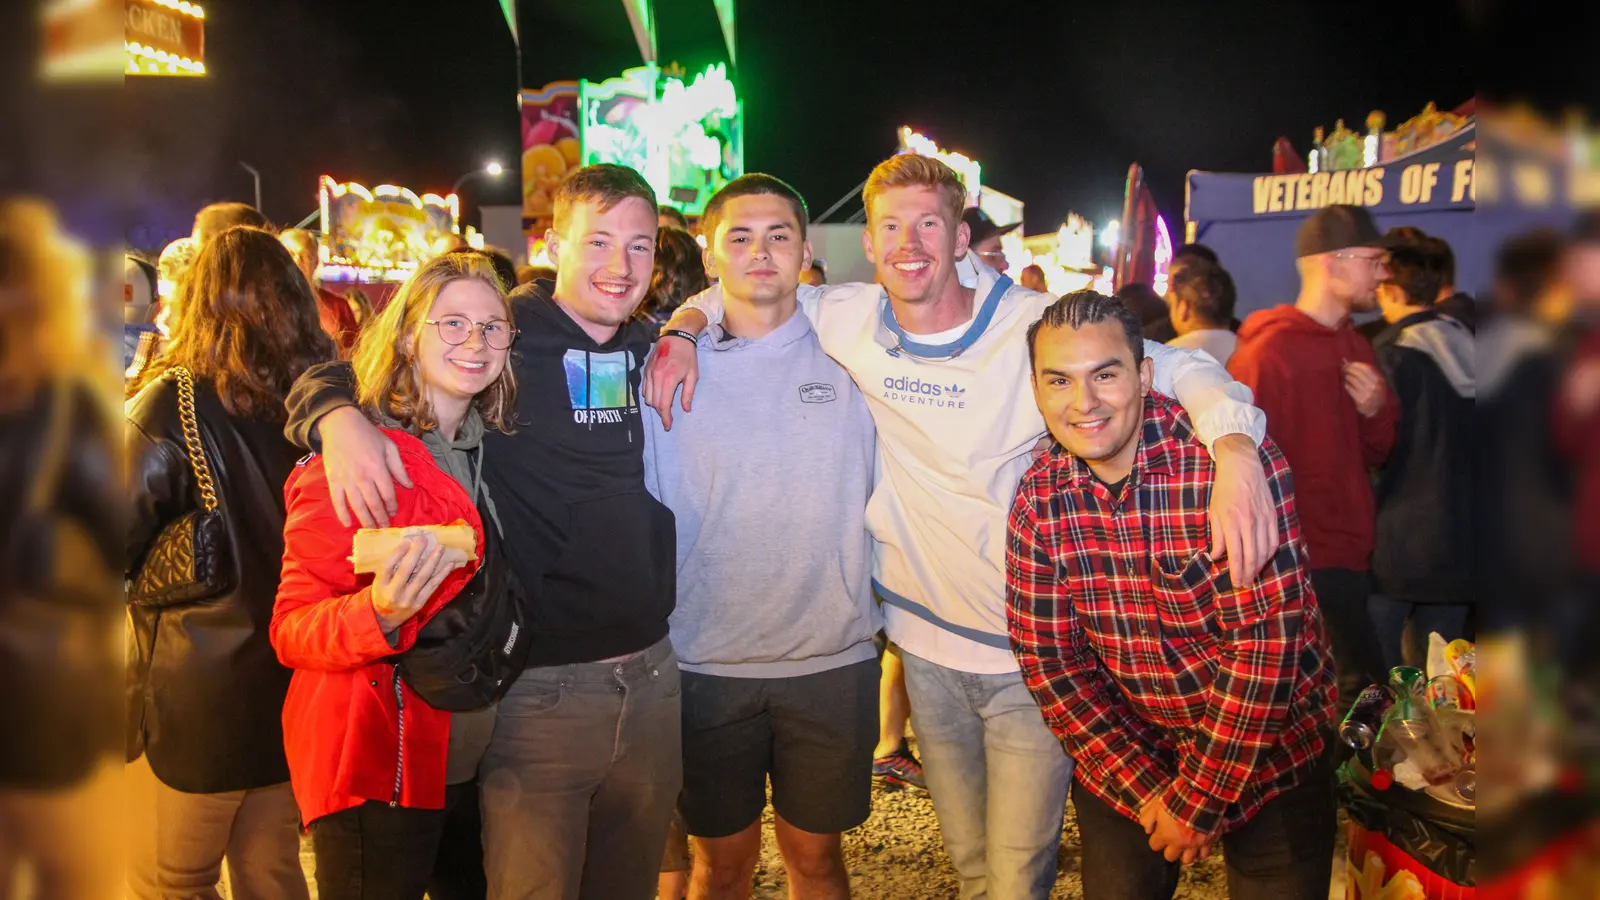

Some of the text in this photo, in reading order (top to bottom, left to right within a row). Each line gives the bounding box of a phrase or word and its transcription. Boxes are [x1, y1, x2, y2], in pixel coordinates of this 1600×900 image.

[1253, 167, 1386, 214] VETERANS
[1400, 162, 1441, 204] OF
[883, 376, 942, 396] adidas
[883, 391, 965, 409] ADVENTURE
[596, 409, 623, 424] PATH
